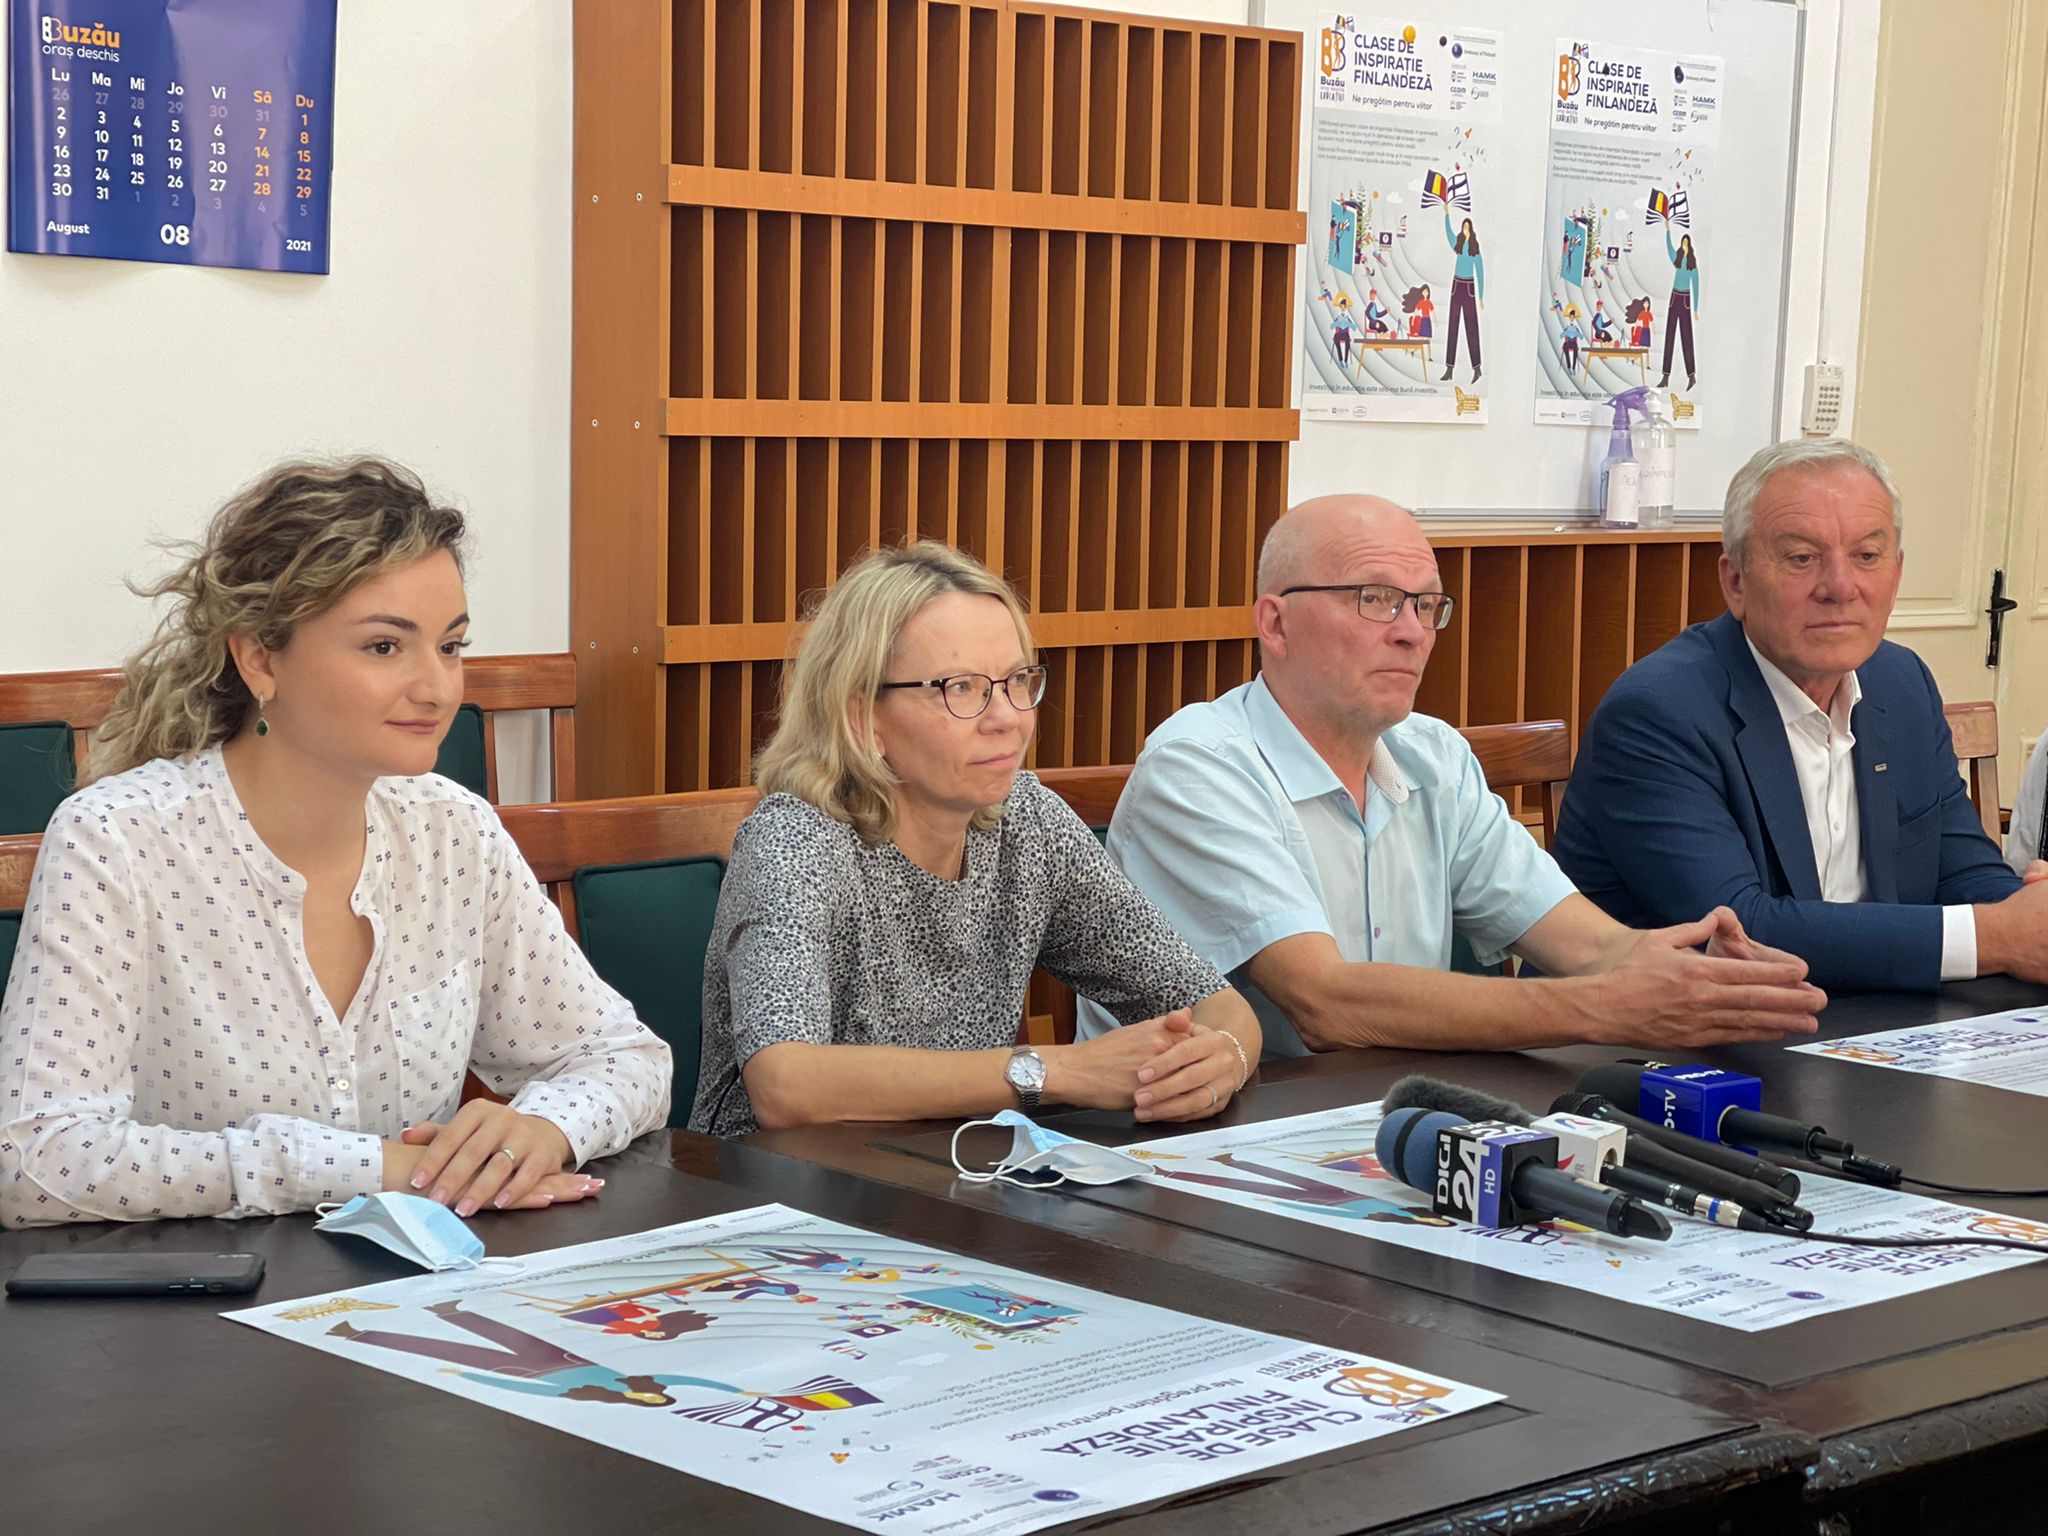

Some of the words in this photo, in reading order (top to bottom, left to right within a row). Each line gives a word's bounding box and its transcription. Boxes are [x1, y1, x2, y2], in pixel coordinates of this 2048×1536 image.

[77, 46, 120, 62] deschis
[1354, 34, 1395, 51] CLASE
[1398, 40, 1415, 54] DE
[1354, 52, 1423, 74] INSPIRAȚIE
[1472, 71, 1497, 80] HAMK
[1627, 65, 1642, 80] DE
[51, 68, 70, 81] Lu
[92, 72, 111, 86] Ma
[130, 77, 144, 91] Mi
[167, 83, 183, 96] Jo
[212, 86, 226, 99] Vi
[254, 90, 272, 103] Sâ
[296, 95, 313, 107] Du
[1353, 70, 1433, 91] FINLANDEZĂ
[1587, 77, 1649, 99] INSPIRAȚIE
[52, 88, 69, 101] 26
[96, 92, 108, 104] 27
[130, 97, 144, 110] 28
[167, 101, 183, 113] 29
[209, 106, 227, 118] 30
[256, 110, 269, 122] 31
[301, 114, 307, 126] 1
[1586, 94, 1658, 114] FINLANDEZĂ
[57, 107, 66, 120] 2
[98, 112, 106, 124] 3
[133, 116, 141, 128] 4
[171, 120, 179, 132] 5
[214, 124, 222, 136] 6
[258, 128, 266, 139] 7
[300, 132, 308, 144] 8
[57, 126, 66, 139] 9
[95, 130, 109, 143] 10
[132, 135, 142, 147] 11
[168, 139, 182, 151] 12
[211, 143, 225, 155] 13
[255, 147, 269, 159] 14
[298, 150, 310, 162] 15
[54, 145, 69, 158] 16
[96, 150, 108, 161] 17
[131, 154, 143, 166] 18
[168, 158, 182, 170] 19
[209, 161, 227, 173] 20
[255, 165, 269, 177] 21
[297, 169, 311, 180] 22
[53, 165, 71, 177] 23
[95, 168, 109, 180] 24
[130, 172, 144, 184] 25
[167, 176, 183, 188] 26
[209, 180, 226, 191] 27
[254, 183, 271, 195] 28
[297, 187, 311, 199] 29
[52, 183, 71, 196] 30
[97, 187, 109, 199] 31
[135, 191, 140, 203] 1
[171, 195, 179, 206] 2
[214, 198, 221, 210] 3
[258, 202, 266, 213] 4
[300, 205, 307, 216] 5
[47, 221, 90, 235] August
[161, 224, 189, 245] 08
[287, 240, 311, 251] 2021
[1437, 1134, 1451, 1205] DIGI
[1452, 1139, 1490, 1224] 24
[1484, 1168, 1496, 1195] HD
[1770, 1228, 1946, 1271] FINNDEZĂ
[1879, 1263, 1933, 1276] DE
[1210, 1378, 1245, 1388] Ne
[1283, 1359, 1359, 1383] Buzău
[1122, 1384, 1212, 1409] pregătim
[1040, 1390, 1293, 1459] FINLANDEZĂ
[1055, 1405, 1125, 1429] pentru
[1101, 1396, 1330, 1458] INSPIRAȚIE
[1234, 1411, 1363, 1447] CLASE
[1005, 1426, 1058, 1442] viitor
[1175, 1442, 1246, 1462] DE
[867, 1492, 960, 1523] HAMK
